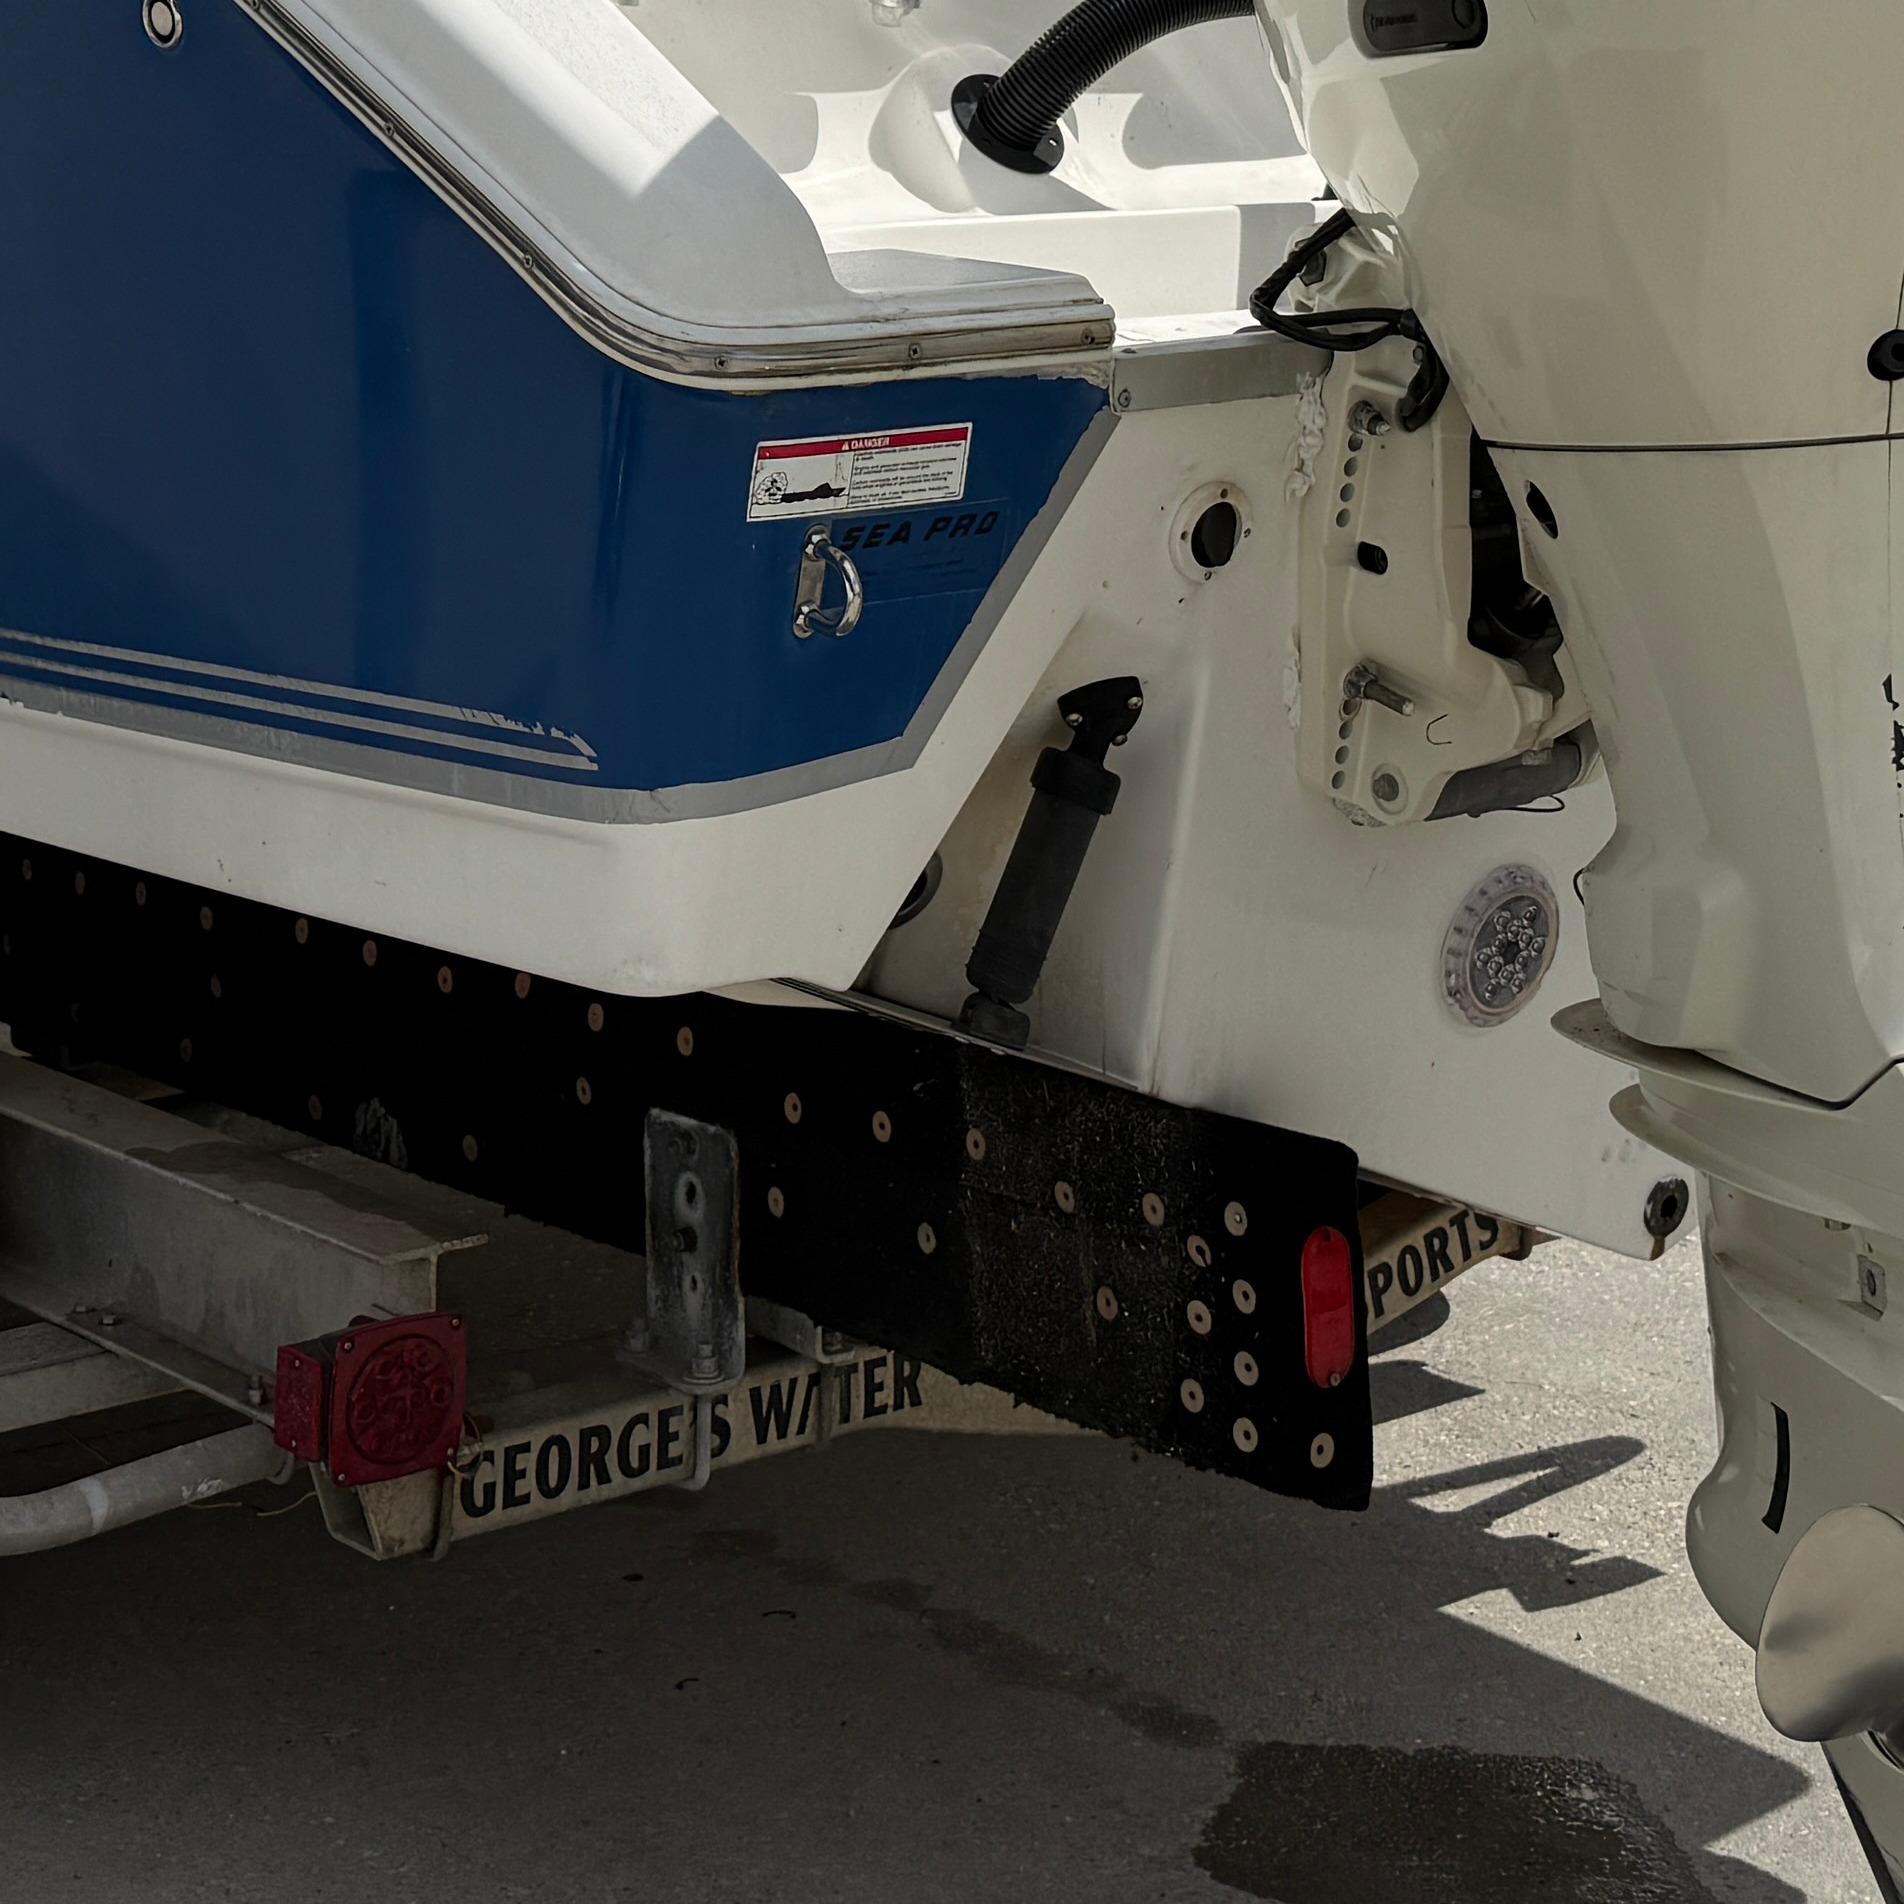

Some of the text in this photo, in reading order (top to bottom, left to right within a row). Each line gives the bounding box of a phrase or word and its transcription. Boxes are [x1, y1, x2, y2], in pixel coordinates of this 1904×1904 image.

[851, 437, 890, 449] DANGER
[840, 511, 1000, 552] SEA PRO
[1367, 1209, 1500, 1319] PORTS
